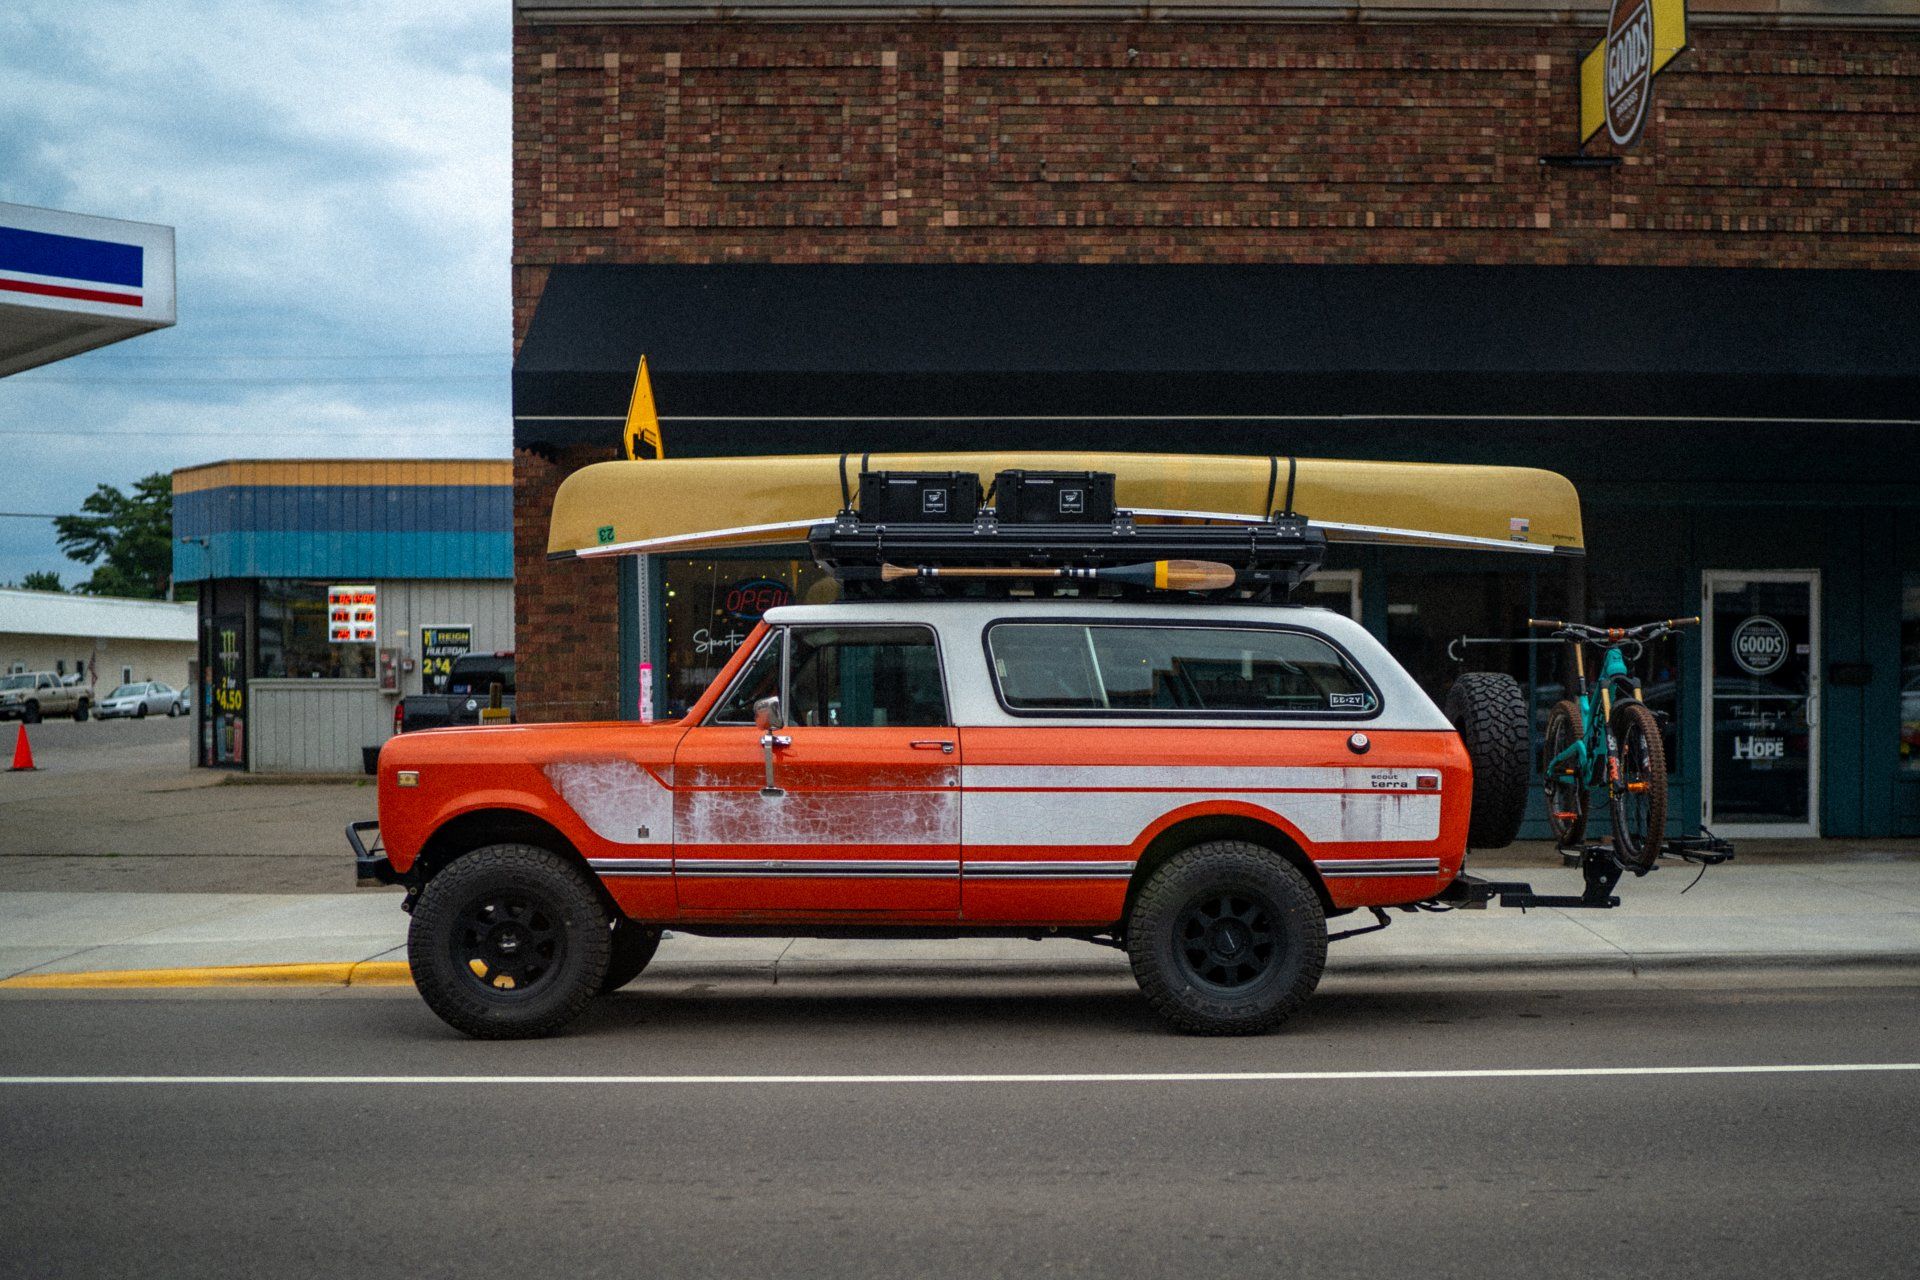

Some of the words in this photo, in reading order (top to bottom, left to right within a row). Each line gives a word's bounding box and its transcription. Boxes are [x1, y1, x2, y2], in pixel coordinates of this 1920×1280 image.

[1609, 13, 1648, 97] GOODS
[599, 528, 614, 542] 23
[725, 589, 789, 612] OPEN
[438, 632, 469, 640] REIGN
[1739, 636, 1781, 653] GOODS
[423, 658, 432, 674] 2
[216, 688, 242, 710] $4.50
[1732, 735, 1784, 760] HOPE
